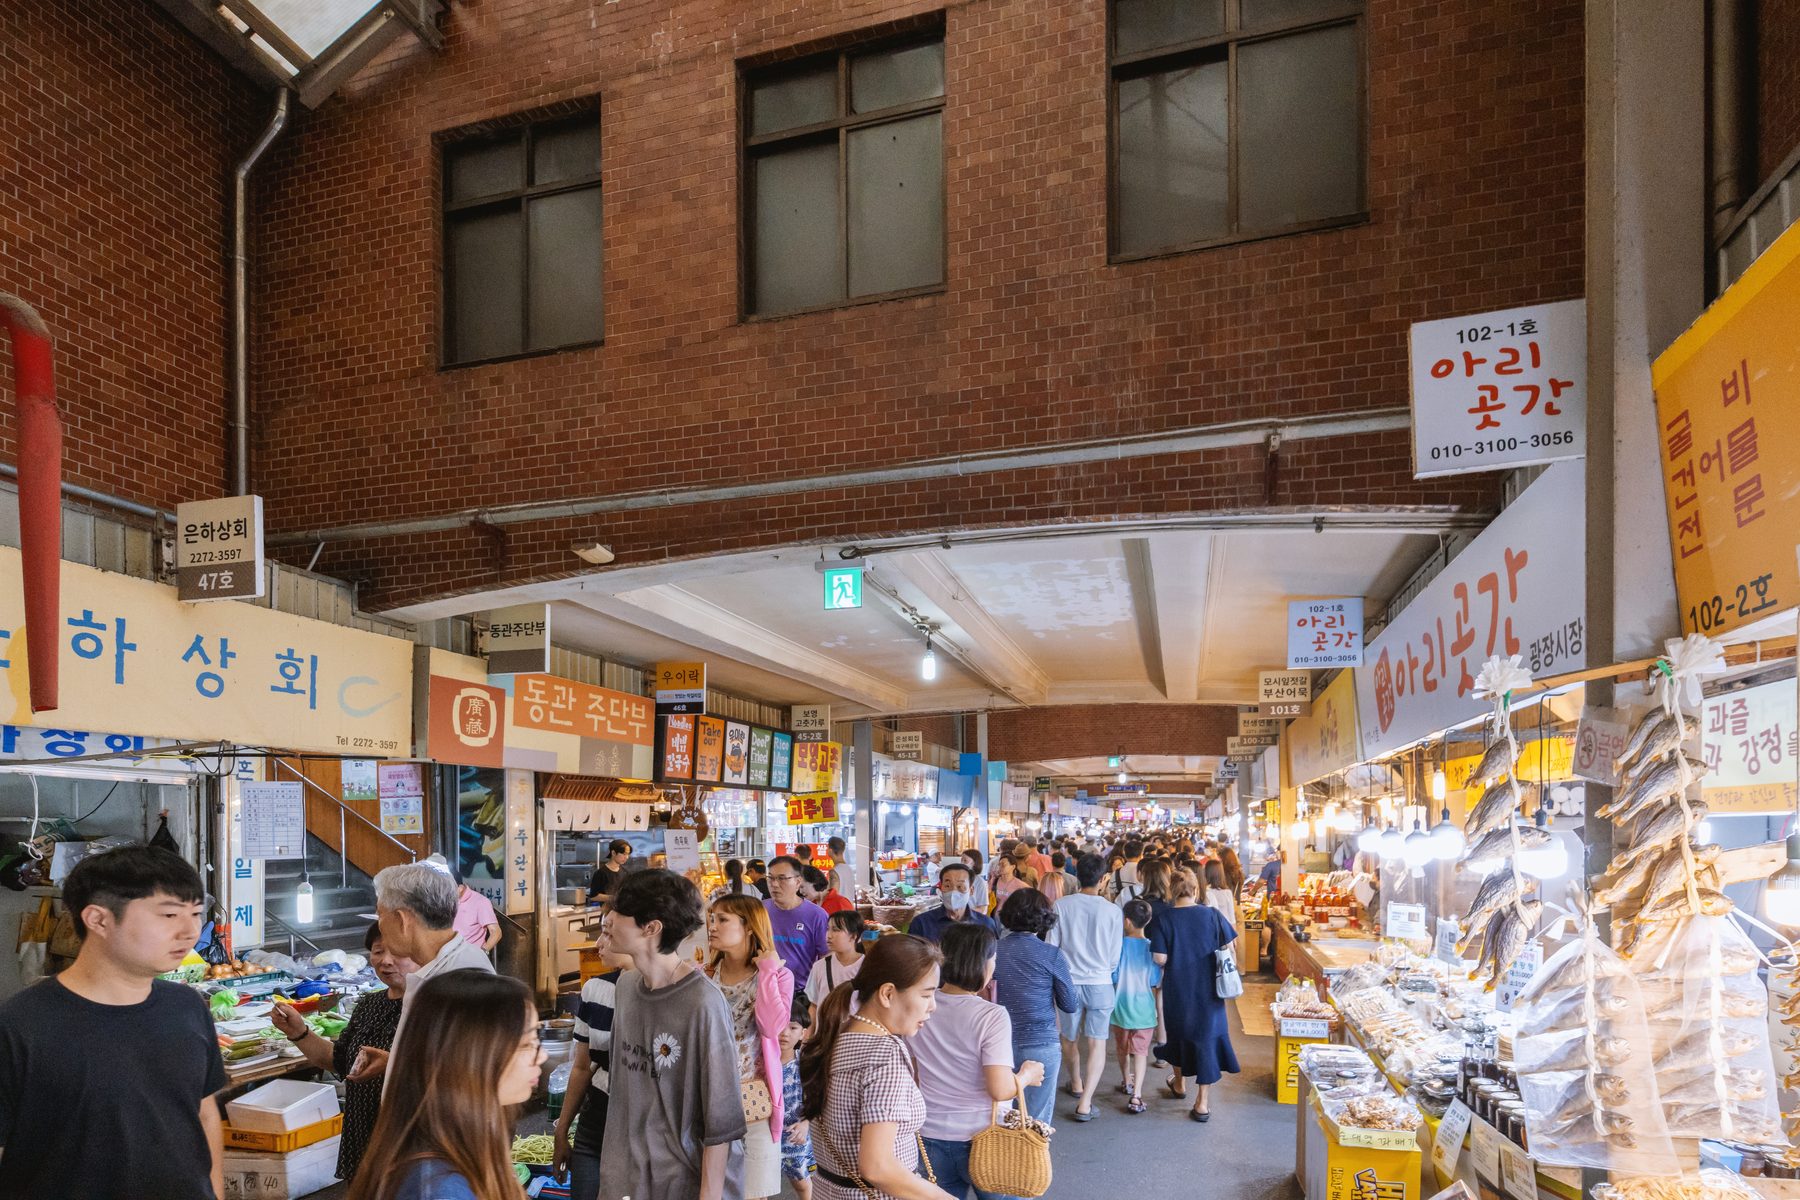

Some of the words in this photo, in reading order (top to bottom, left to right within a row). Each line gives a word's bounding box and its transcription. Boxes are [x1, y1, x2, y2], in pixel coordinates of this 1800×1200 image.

[1456, 319, 1538, 344] 102-1호
[1430, 341, 1541, 378] 아리
[1467, 377, 1574, 431] 곳간
[1430, 430, 1574, 460] 010-3100-3056
[184, 517, 248, 545] 은하상회
[190, 548, 242, 564] 2272-3597
[198, 569, 235, 592] 47호
[1308, 604, 1345, 613] 102-1호
[1689, 573, 1778, 633] 102-2호
[489, 620, 547, 639] 동관주단부
[1296, 614, 1345, 629] 아리
[1395, 546, 1529, 698] 아리곳간
[1311, 631, 1358, 652] 곳간
[1528, 616, 1585, 674] 광장시장
[1294, 654, 1357, 664] 010-3100-3056
[661, 669, 699, 685] 우이락
[1263, 687, 1308, 699] 부산어묵
[522, 678, 577, 728] 동관
[584, 692, 648, 739] 주단부
[803, 709, 818, 718] 보영
[1270, 705, 1301, 715] 101호
[1708, 698, 1750, 736] 과즐
[700, 721, 722, 738] Take
[795, 718, 825, 728] 고춧가루
[336, 735, 349, 746] Tel
[352, 736, 399, 751] 2272-3597
[703, 738, 717, 746] OUT
[797, 731, 824, 741] 45-2호
